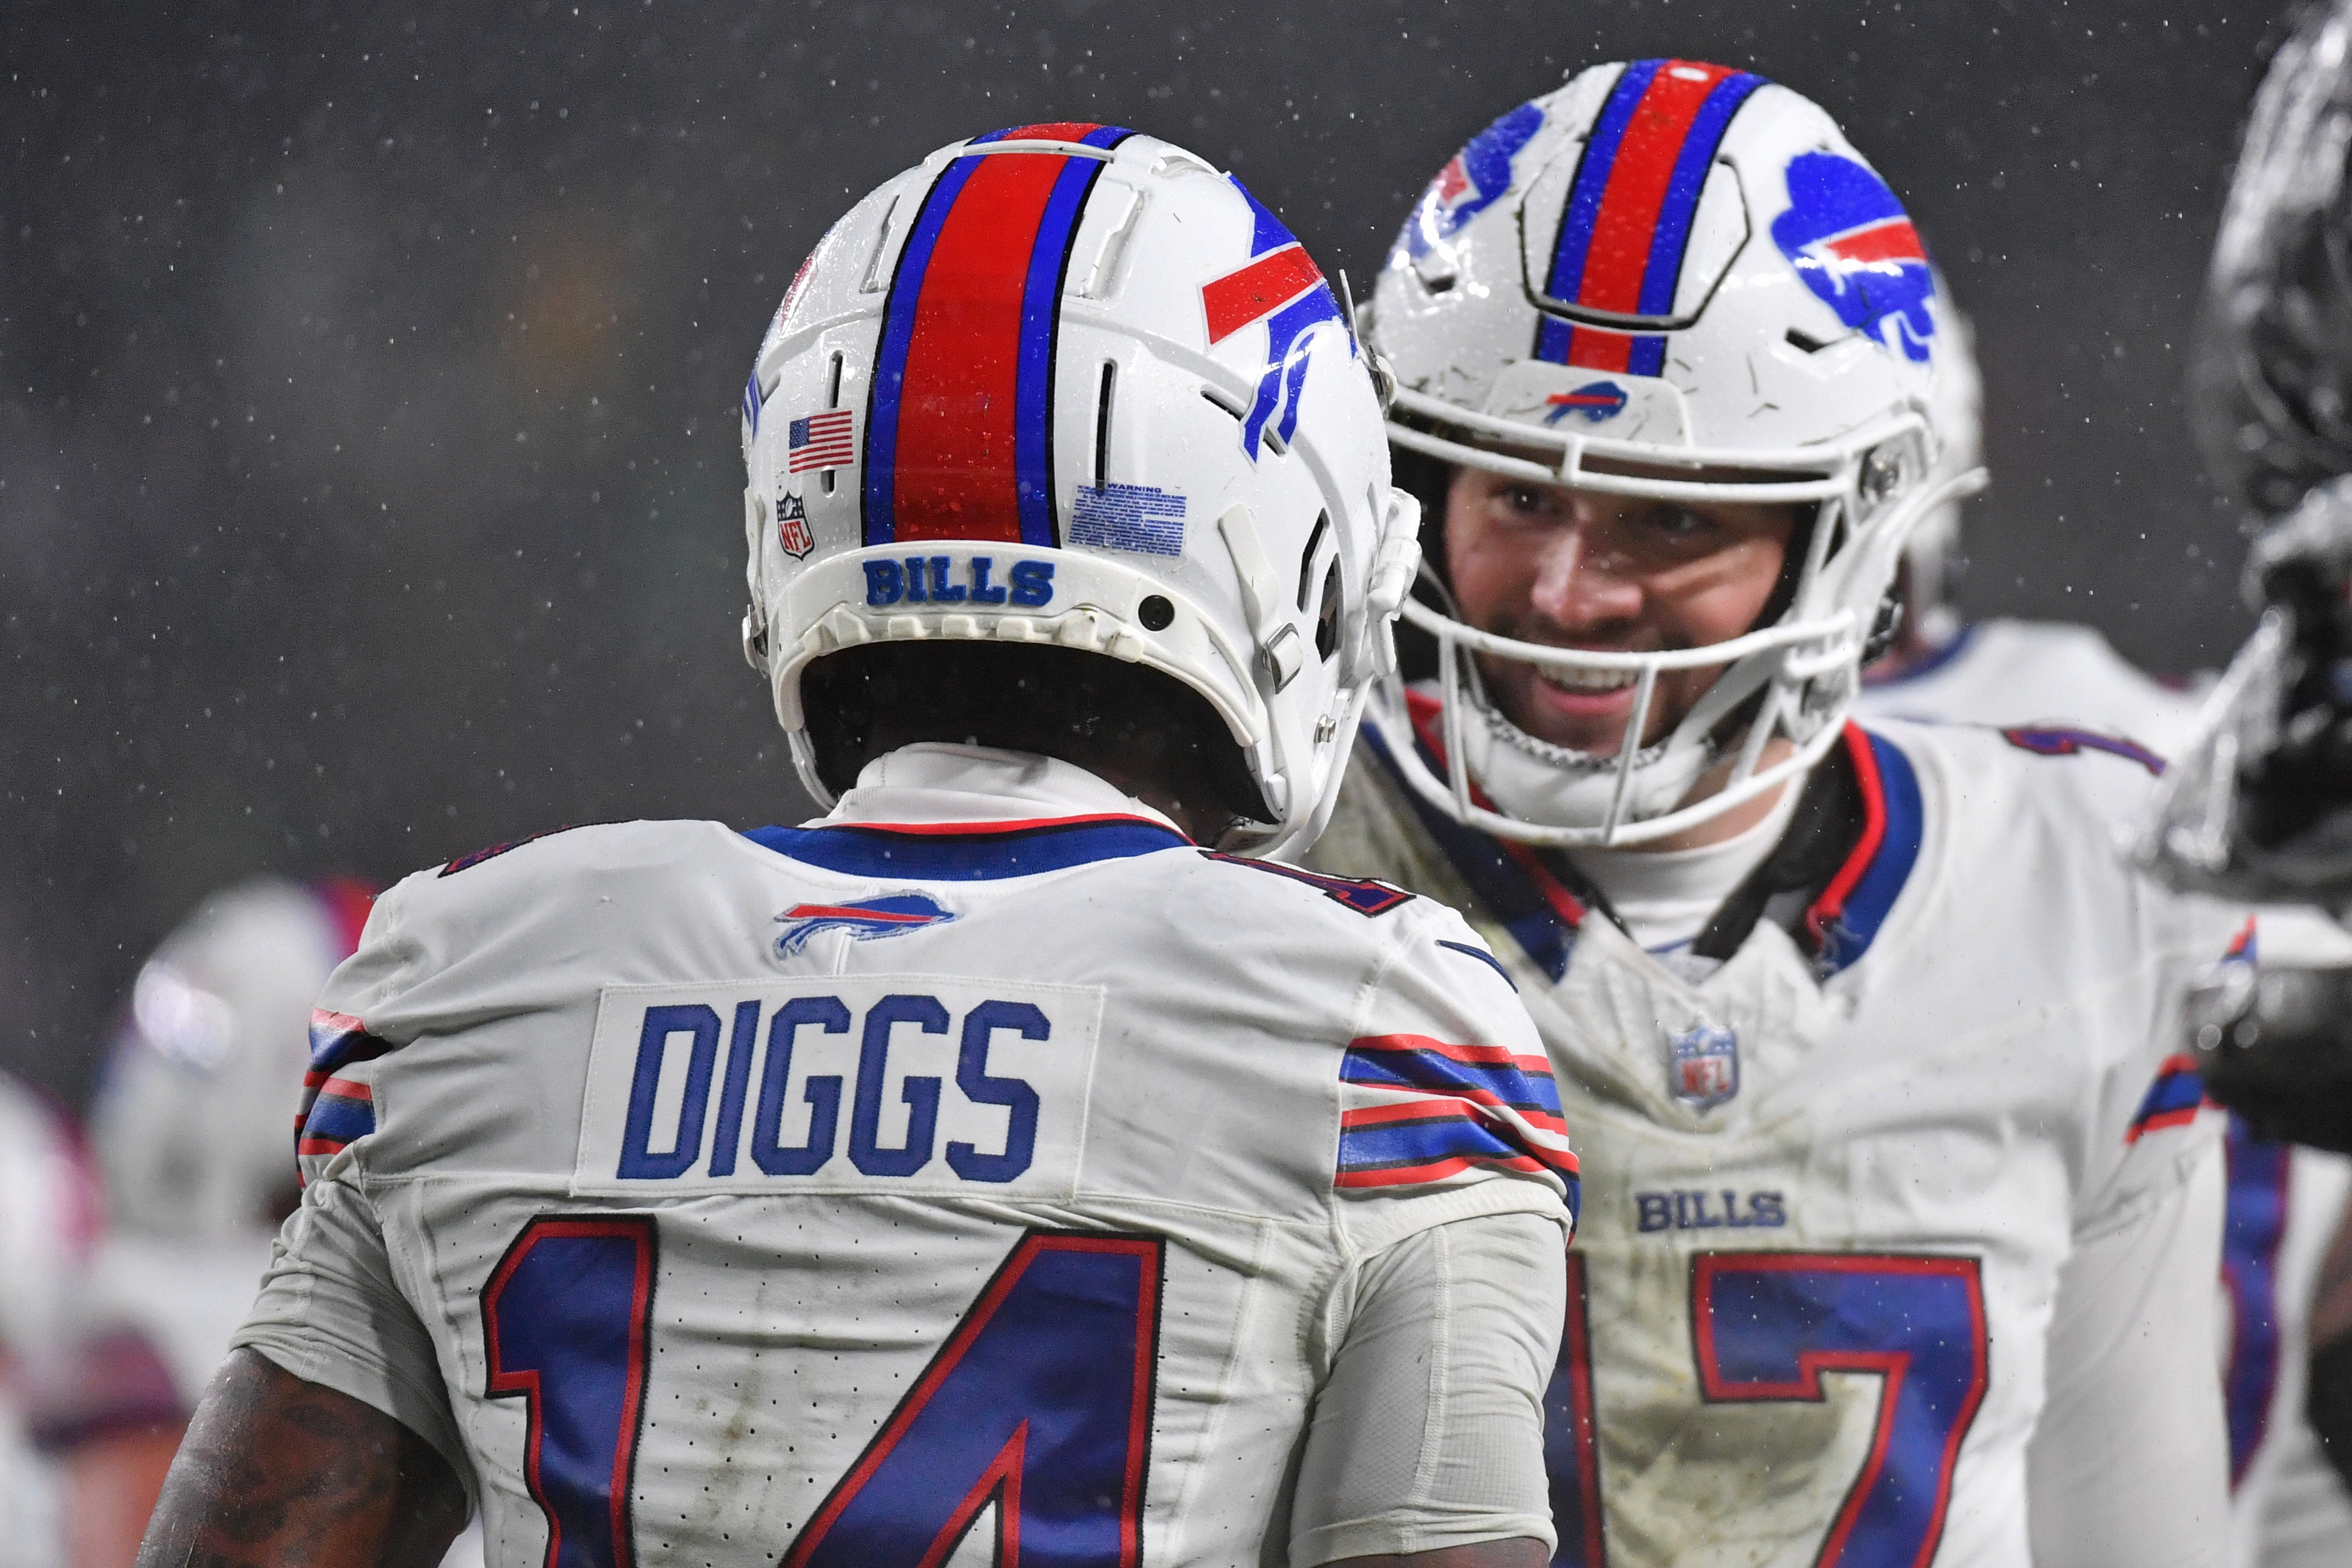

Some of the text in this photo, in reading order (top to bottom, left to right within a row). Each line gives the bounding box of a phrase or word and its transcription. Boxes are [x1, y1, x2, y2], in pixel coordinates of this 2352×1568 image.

[1107, 483, 1162, 493] WARNING
[779, 521, 811, 553] NFL
[863, 556, 1055, 606] BILLS
[616, 994, 1052, 1183] DIGGS
[1634, 1188, 1787, 1233] BILLS
[480, 1212, 1166, 1568] 14
